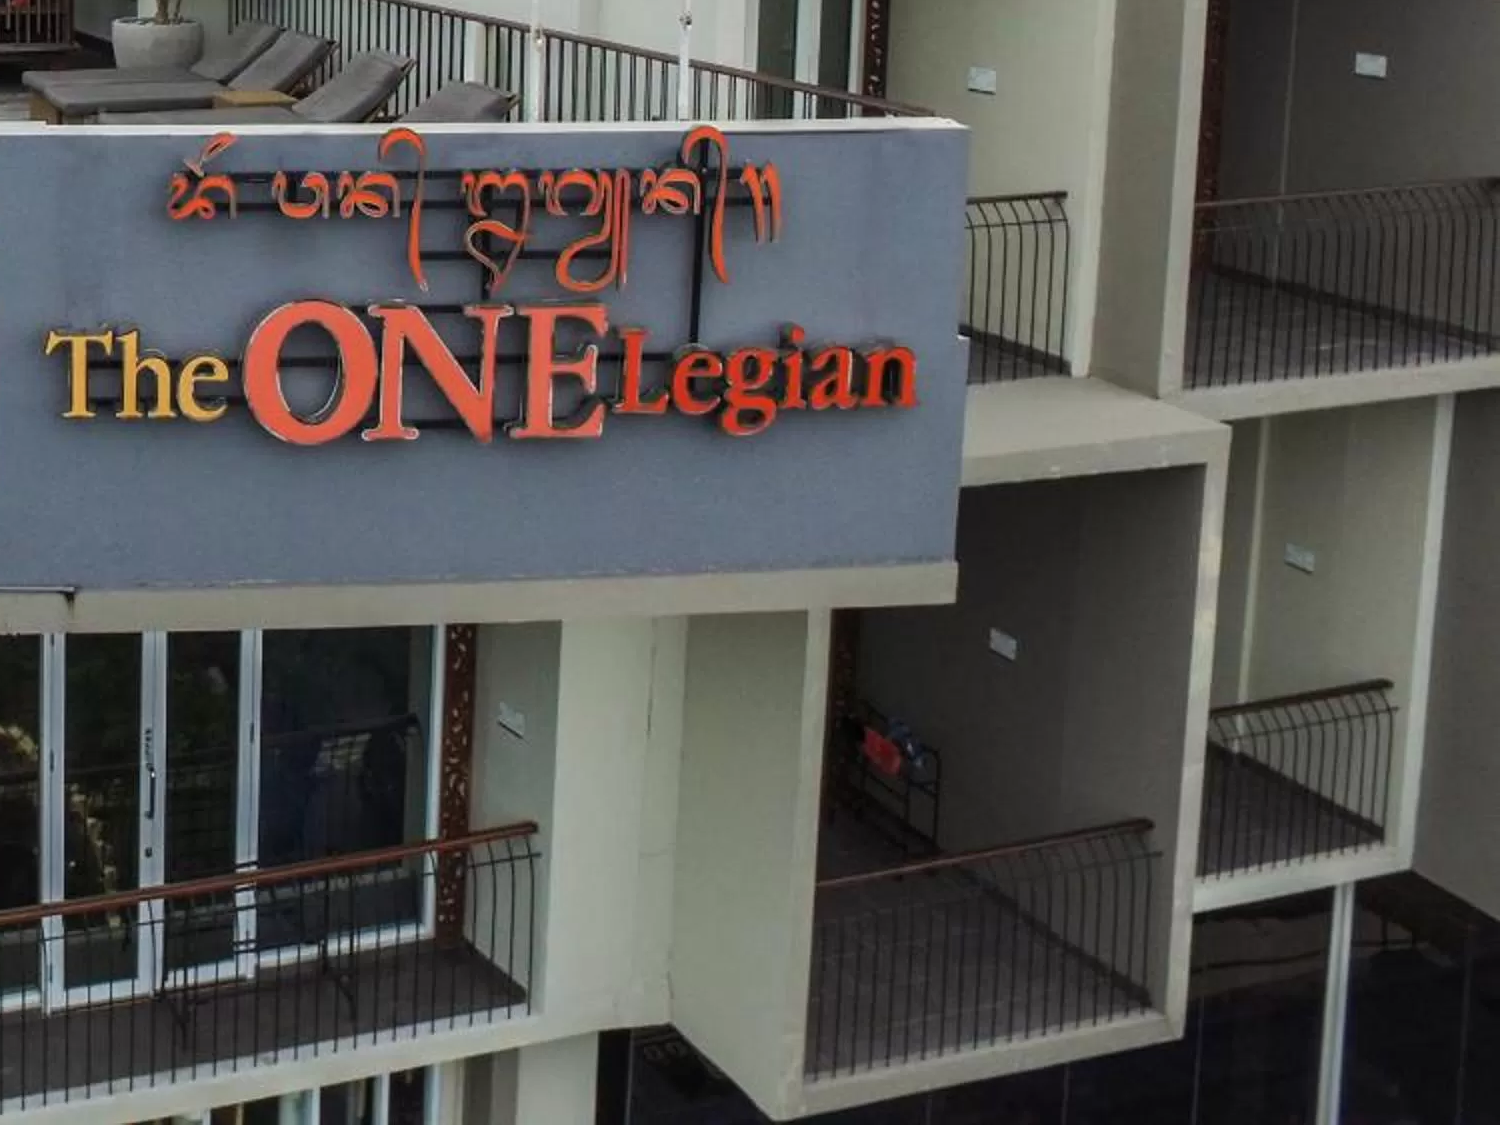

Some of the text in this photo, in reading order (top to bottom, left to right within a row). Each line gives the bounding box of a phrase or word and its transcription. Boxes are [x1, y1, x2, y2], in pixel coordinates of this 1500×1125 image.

[45, 299, 919, 445] The ONE Legian
